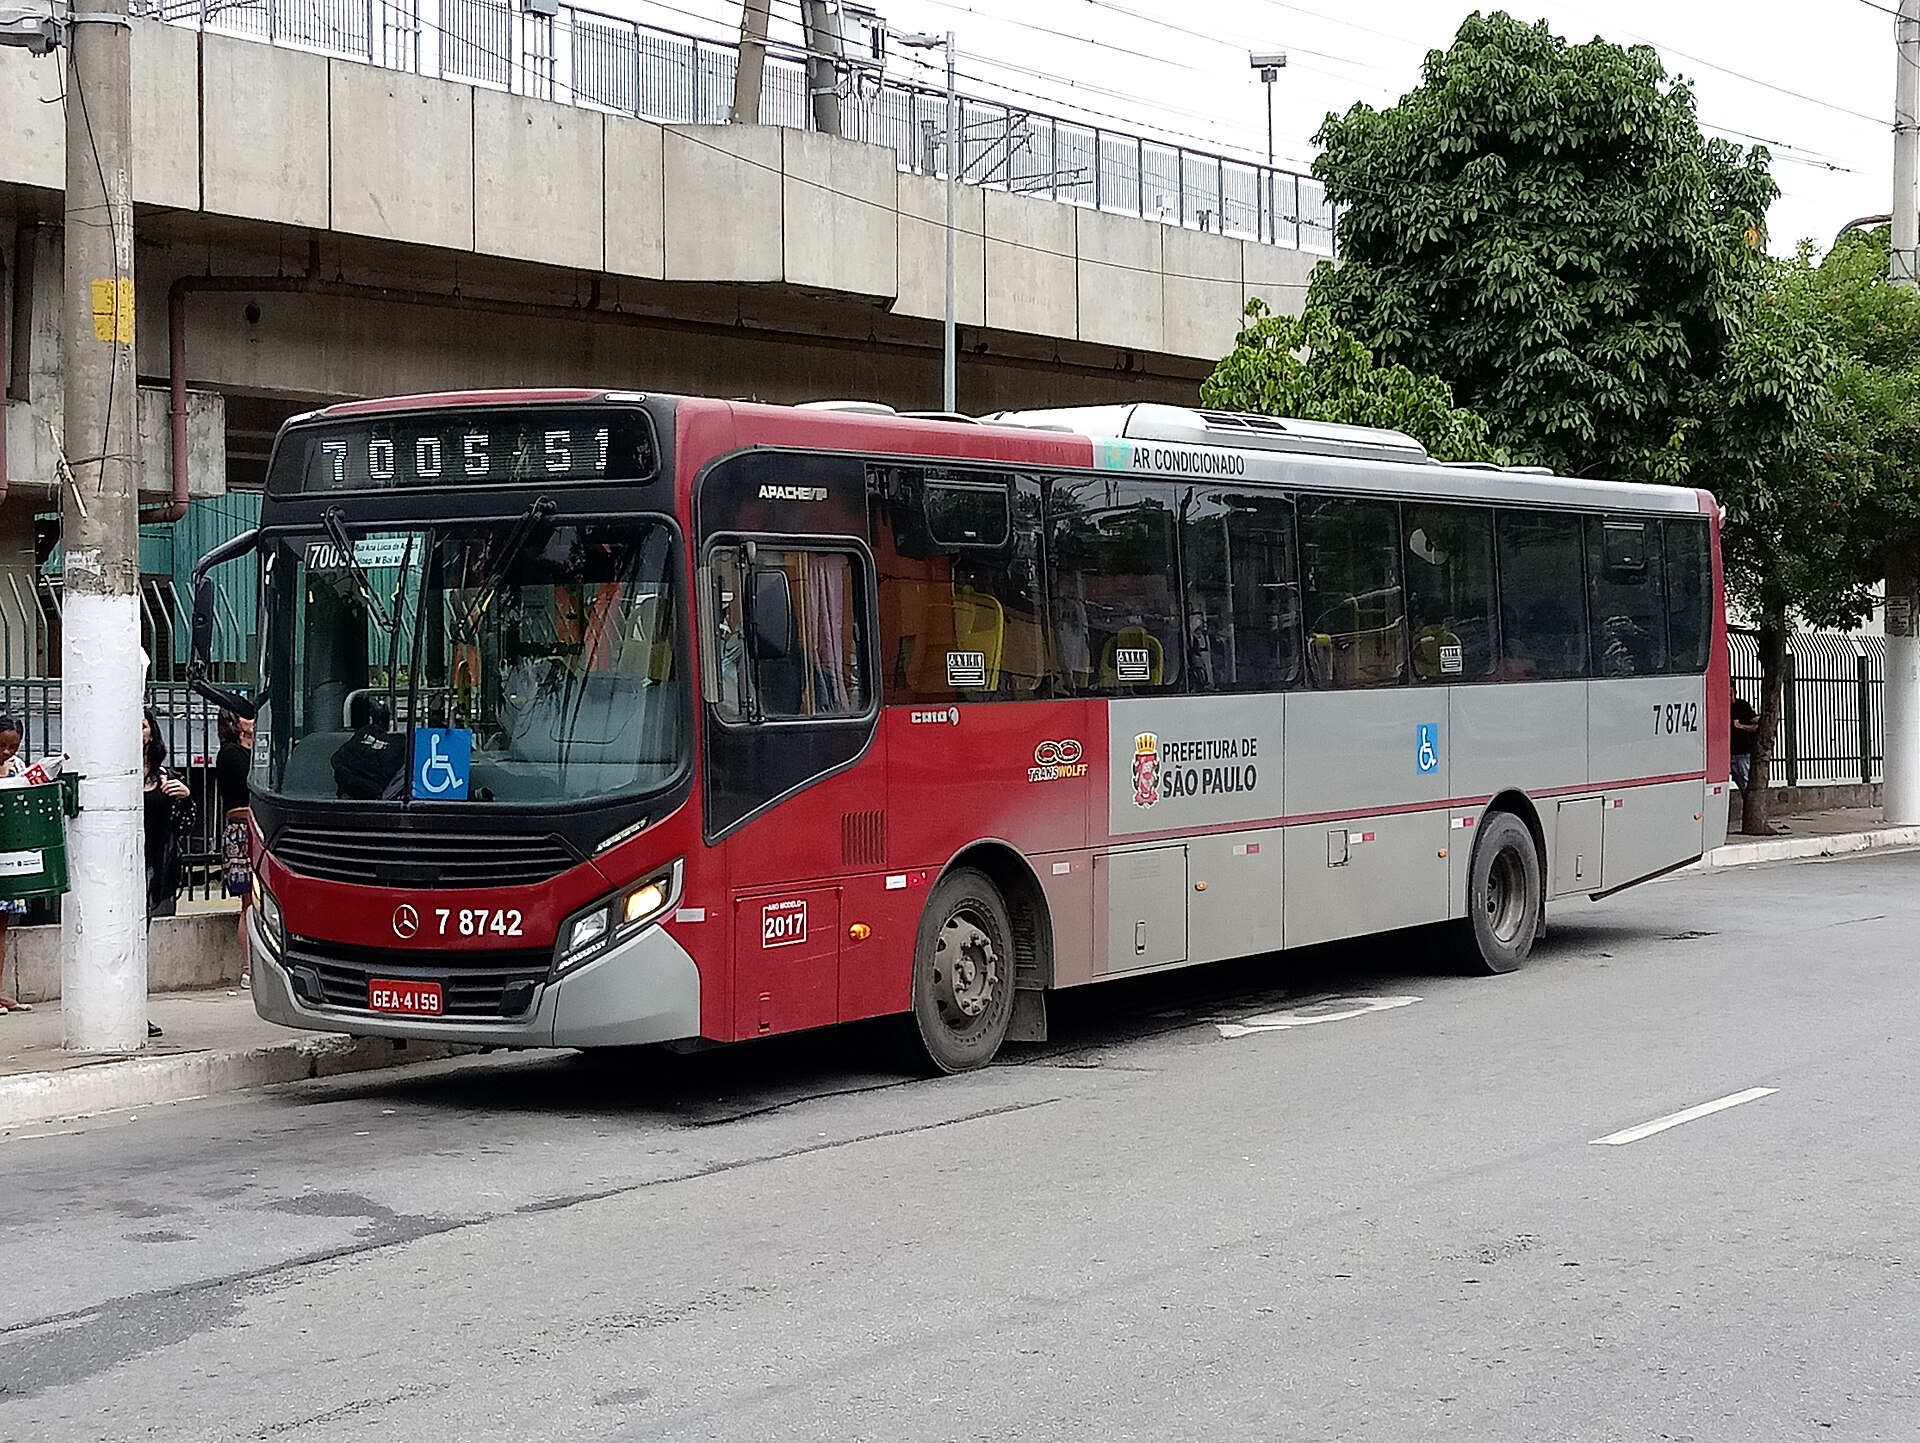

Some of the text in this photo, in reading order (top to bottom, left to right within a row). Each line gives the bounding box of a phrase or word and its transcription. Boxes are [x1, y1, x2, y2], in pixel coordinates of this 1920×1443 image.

[1132, 446, 1245, 476] AR CONDICIONADO
[911, 711, 948, 724] CAIO
[1653, 702, 1697, 735] 7 8742
[1162, 737, 1257, 763] PREFEITURA DE
[1027, 764, 1089, 783] TRANSWOLFF
[1162, 764, 1257, 798] SÃO PAULO
[767, 899, 802, 911] ANO MODELO
[435, 908, 523, 936] 7 8742
[765, 912, 804, 939] 2017
